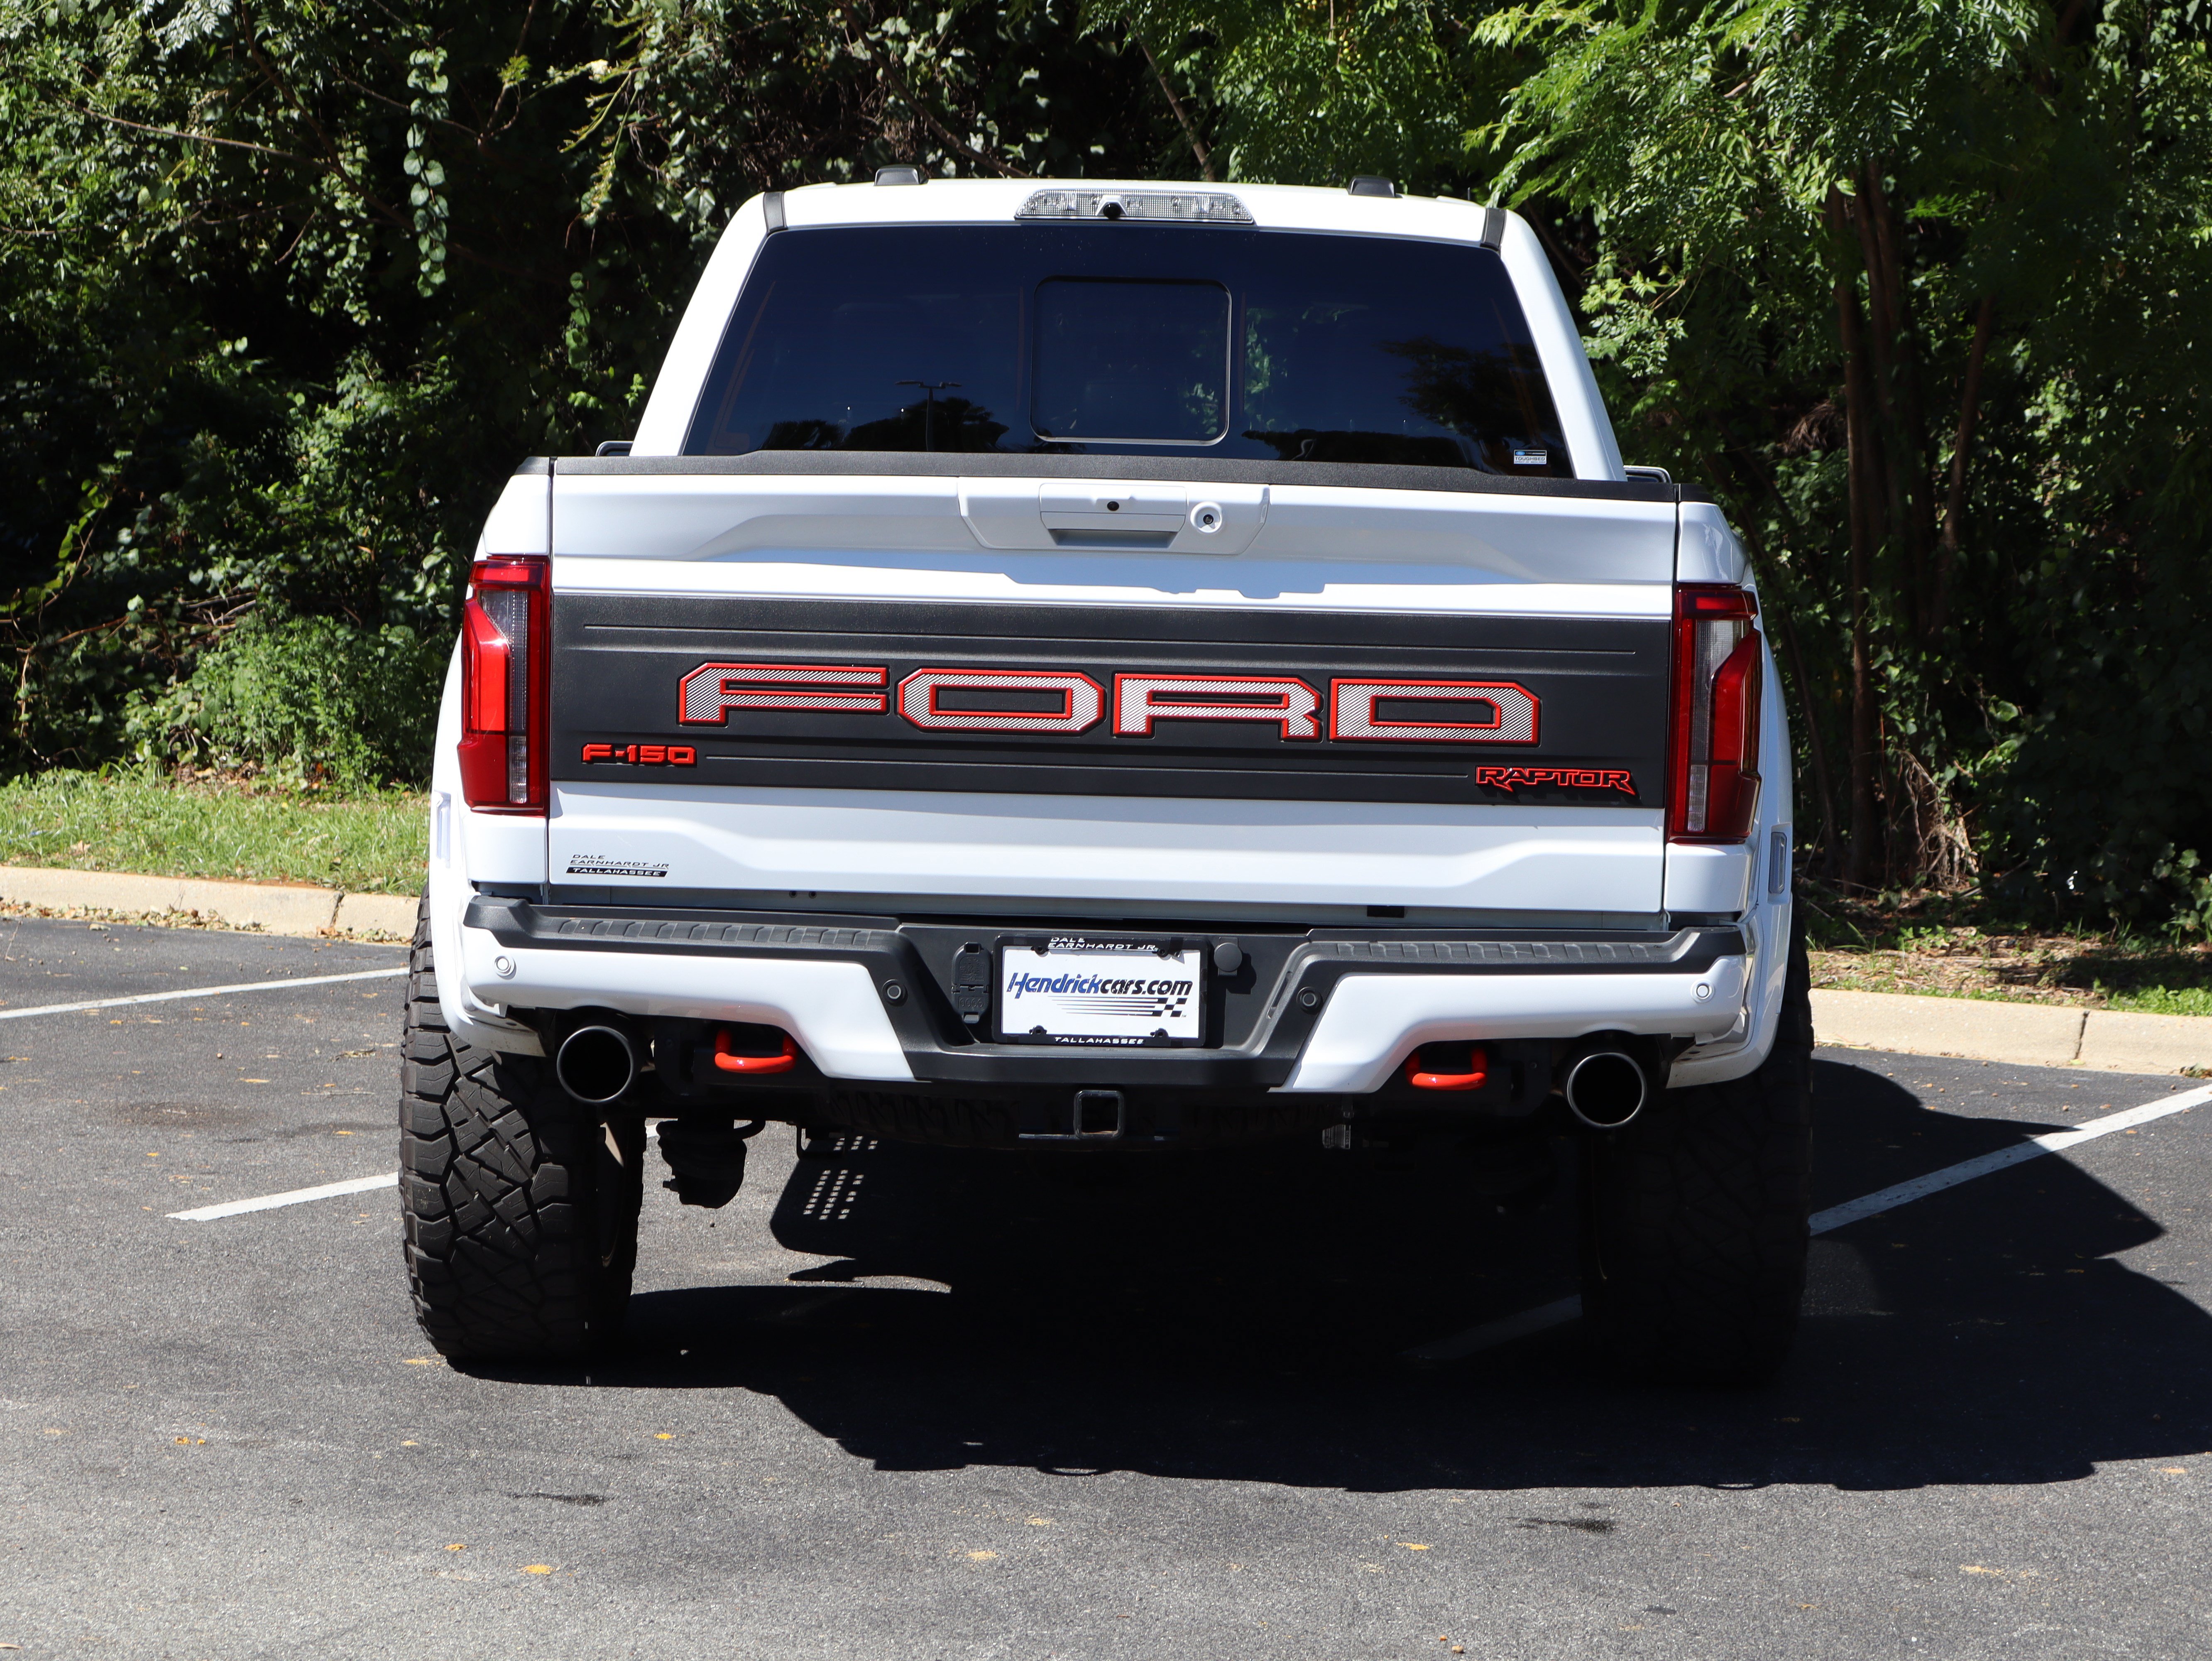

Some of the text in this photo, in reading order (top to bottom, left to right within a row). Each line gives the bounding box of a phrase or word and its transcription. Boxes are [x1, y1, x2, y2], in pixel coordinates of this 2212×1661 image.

[679, 662, 1539, 744] FORD
[583, 744, 695, 764] F-150
[1476, 766, 1636, 796] RAPTOR
[573, 868, 661, 877] TALLAHASSEE
[1006, 973, 1194, 999] Hendrickcars.com
